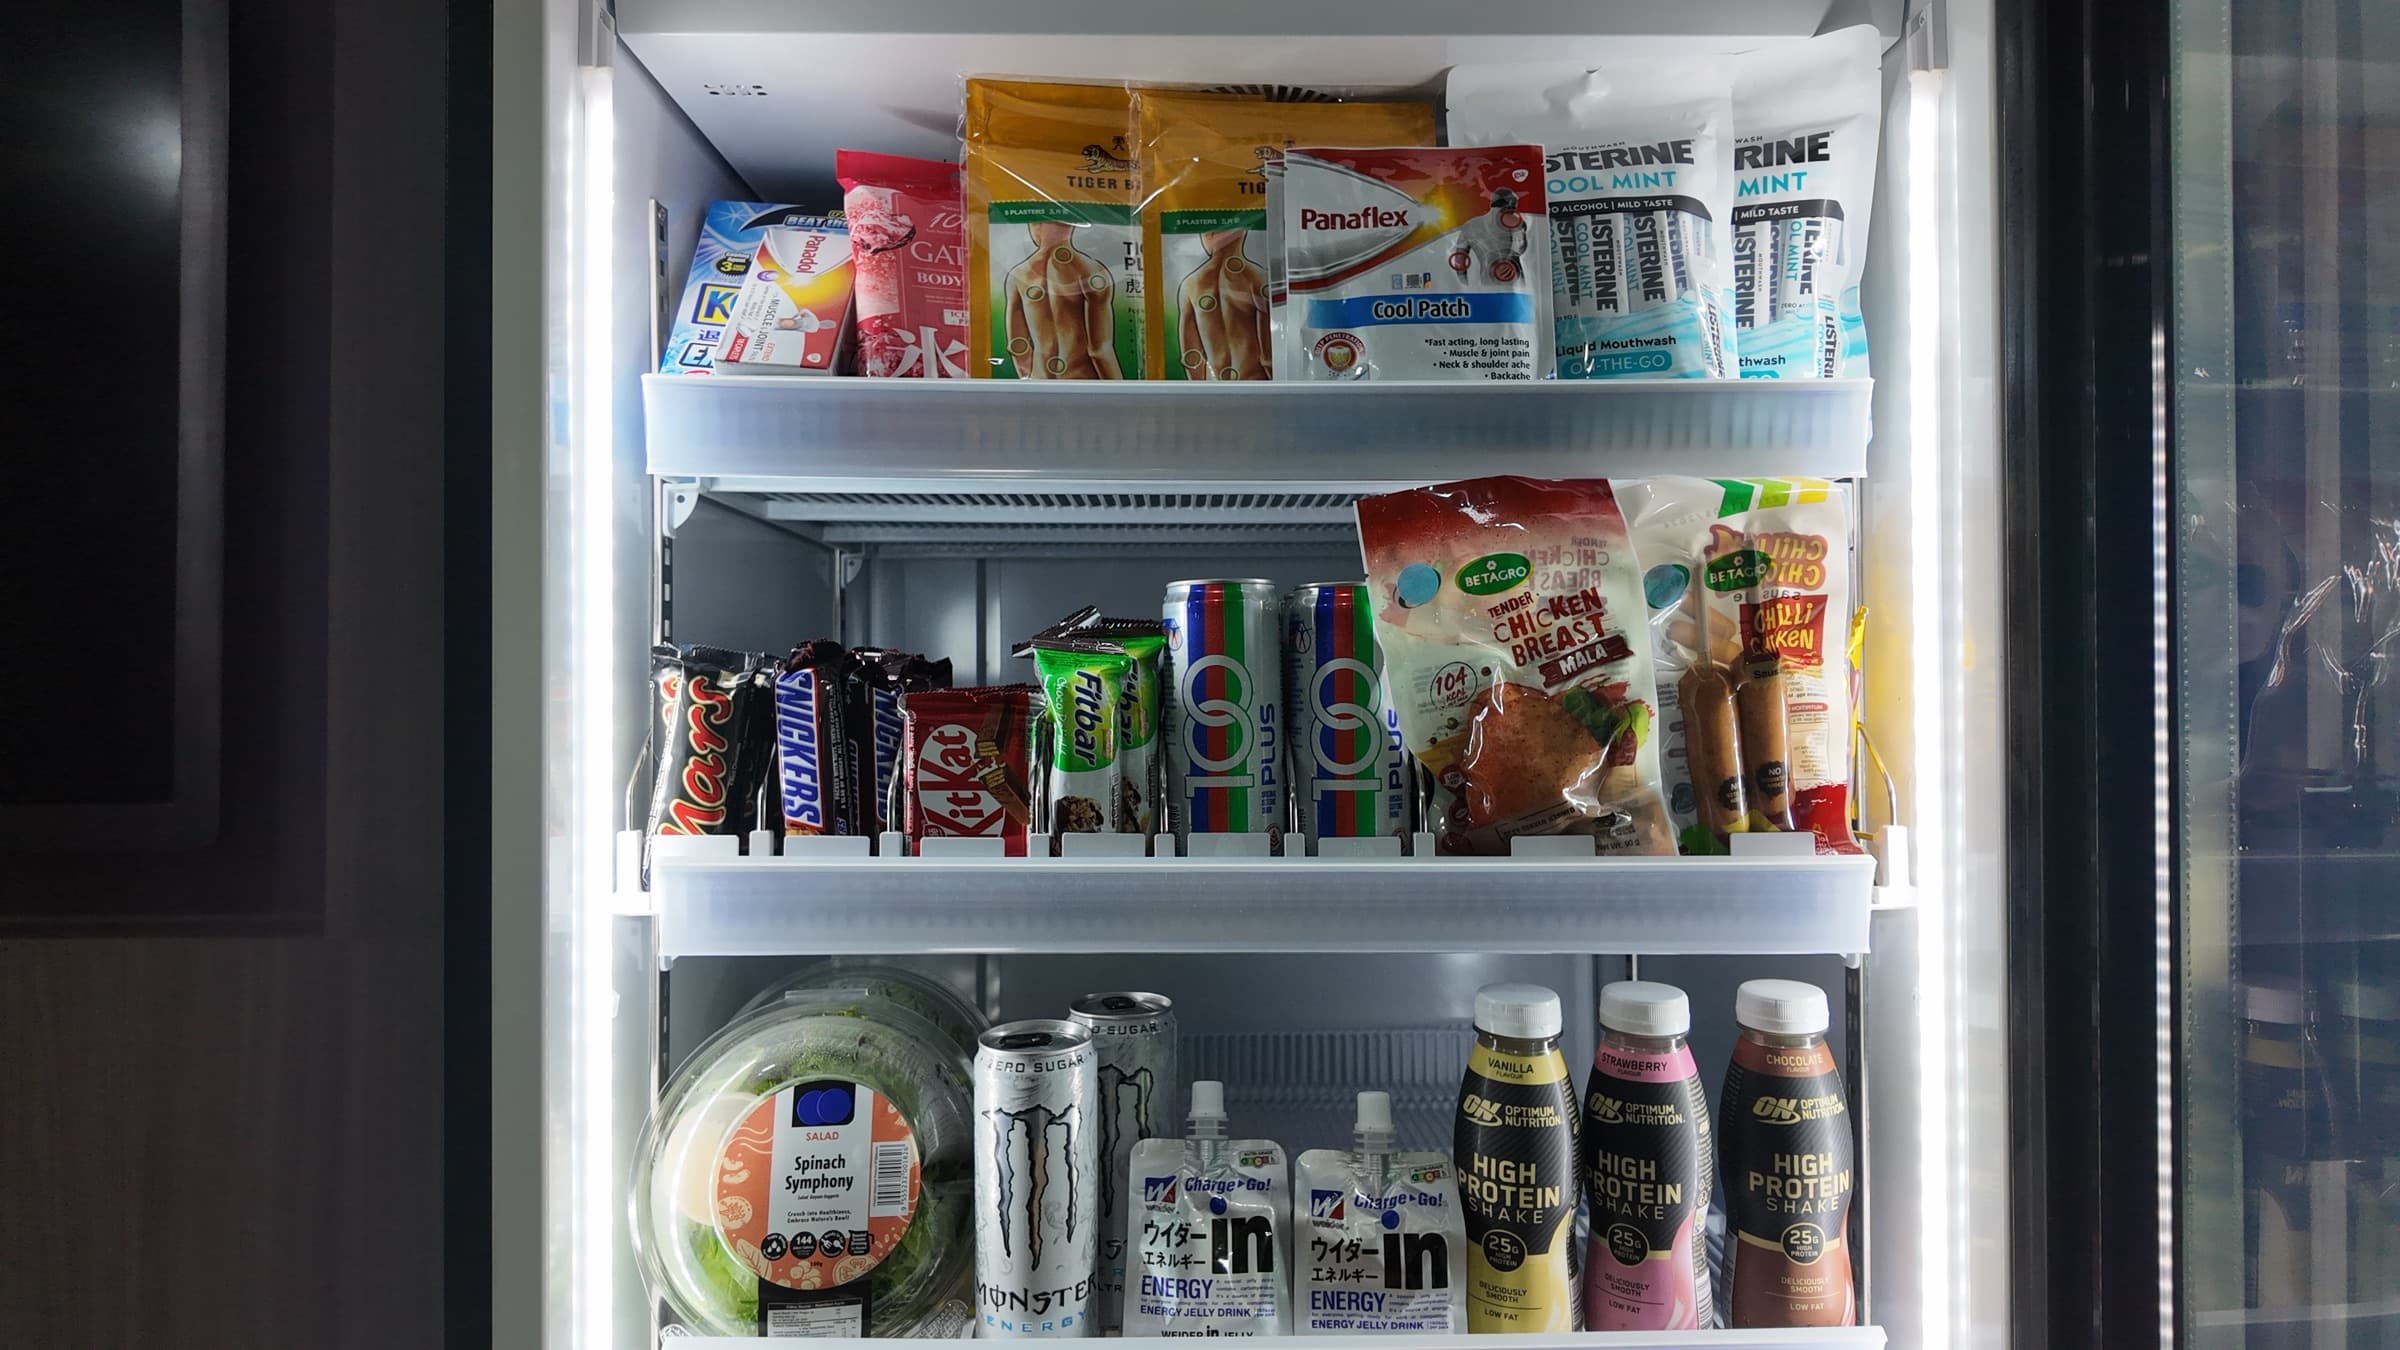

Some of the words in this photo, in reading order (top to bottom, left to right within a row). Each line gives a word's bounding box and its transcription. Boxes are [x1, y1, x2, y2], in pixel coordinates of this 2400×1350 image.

[1545, 139, 1695, 173] STERINE
[1067, 176, 1118, 190] TIGER
[1238, 181, 1267, 194] TIG
[1547, 175, 1603, 194] OOL
[1612, 171, 1676, 189] MINT
[1738, 171, 1808, 197] MINT
[1562, 202, 1609, 213] ALCOHOL
[1617, 200, 1641, 209] MILD
[1643, 199, 1673, 208] TASTE
[1740, 209, 1766, 219] MILD
[1768, 206, 1799, 216] TASTE
[1301, 206, 1409, 231] Panaflex
[1576, 223, 1589, 259] COOL
[796, 235, 827, 274] Panadol
[911, 241, 965, 266] GAT
[1785, 245, 1800, 281] MINT
[1580, 264, 1593, 299] MINT
[1374, 300, 1412, 319] Cool
[1418, 299, 1470, 318] Patch
[1428, 338, 1446, 347] Fast
[1448, 338, 1478, 348] acting,
[1480, 338, 1499, 348] long
[1501, 337, 1530, 348] lasting
[1600, 335, 1677, 351] Mouthwash
[1450, 349, 1479, 358] Muscle
[1489, 349, 1510, 359] joint
[1512, 349, 1530, 359] pain
[1739, 354, 1787, 367] thwash
[1439, 360, 1461, 369] Neck
[1471, 360, 1509, 369] shoulder
[1511, 361, 1531, 369] ache
[1491, 372, 1531, 380] Backache
[1465, 566, 1528, 588] BETAGRO
[1488, 591, 1535, 618] TENDER
[1493, 587, 1604, 643] CHICKEN
[1511, 612, 1606, 668] BREAST
[1558, 643, 1608, 676] MALA
[1436, 666, 1468, 697] 104
[1074, 670, 1104, 767] Fitbar
[774, 668, 822, 827] SNICKERS
[1259, 703, 1277, 786] PLUS
[1107, 1022, 1159, 1035] SUGAR
[987, 1058, 1025, 1074] ZERO
[1034, 1054, 1086, 1073] SUGAR
[1488, 1057, 1534, 1074] VANILLA
[1601, 1052, 1668, 1073] STRAWBERRY
[1766, 1053, 1825, 1066] CHOCOLATE
[1626, 1103, 1675, 1115] OPTIMUM
[1800, 1093, 1839, 1110] OPTIMUM
[1505, 1105, 1555, 1118] OPTIMUM
[1626, 1113, 1686, 1126] NUTRITION
[1801, 1105, 1845, 1121] NUTRITION
[1505, 1116, 1562, 1128] NUTRITION
[805, 1131, 840, 1142] SALAD
[794, 1153, 846, 1175] Spinach
[1473, 1152, 1537, 1185] HIGH
[1599, 1152, 1656, 1181] HIGH
[1774, 1151, 1833, 1176] HIGH
[785, 1173, 854, 1194] Symphony
[1185, 1177, 1236, 1194] Charge
[1246, 1178, 1272, 1192] Go!
[1458, 1168, 1561, 1209] PROTEIN
[1584, 1166, 1682, 1205] PROTEIN
[1749, 1169, 1850, 1200] PROTEIN
[1354, 1192, 1407, 1210] Charge
[1418, 1193, 1443, 1207] Go!
[1468, 1196, 1544, 1225] SHAKE
[1594, 1192, 1665, 1220] SHAKE
[1766, 1197, 1840, 1215] SHAKE
[796, 1234, 813, 1245] 144
[1144, 1220, 1207, 1248] ウイダー
[1209, 1196, 1274, 1275] in
[1311, 1237, 1379, 1263] ウイダー
[1381, 1210, 1449, 1291] in
[1614, 1250, 1640, 1262] PROTEIN
[1790, 1249, 1819, 1258] PROTEIN
[1143, 1251, 1206, 1270] エネルギー
[1489, 1256, 1518, 1268] PROTEIN
[1311, 1267, 1378, 1283] エネルギー
[1604, 1273, 1650, 1291] DELICIOUSLY
[1141, 1275, 1213, 1299] ENERGY
[1479, 1280, 1528, 1297] DELICIOUSLY
[1610, 1283, 1642, 1297] SMOOTH
[1790, 1285, 1824, 1294] SMOOTH
[1311, 1290, 1386, 1313] ENERGY
[1486, 1291, 1519, 1304] SMOOTH
[1790, 1303, 1808, 1311] LOW
[1811, 1303, 1825, 1311] FAT
[1140, 1305, 1183, 1317] ENERGY
[1183, 1306, 1217, 1318] JELLY
[1217, 1308, 1251, 1318] DRINK
[1484, 1308, 1501, 1319] LOW
[1503, 1312, 1520, 1322] FAT
[1608, 1300, 1625, 1311] LOW
[1626, 1305, 1641, 1315] FAT
[986, 1307, 1088, 1333] ENERGY
[1311, 1319, 1355, 1330] ENERGY
[1356, 1320, 1388, 1330] JELLY
[1390, 1321, 1425, 1330] DRINK
